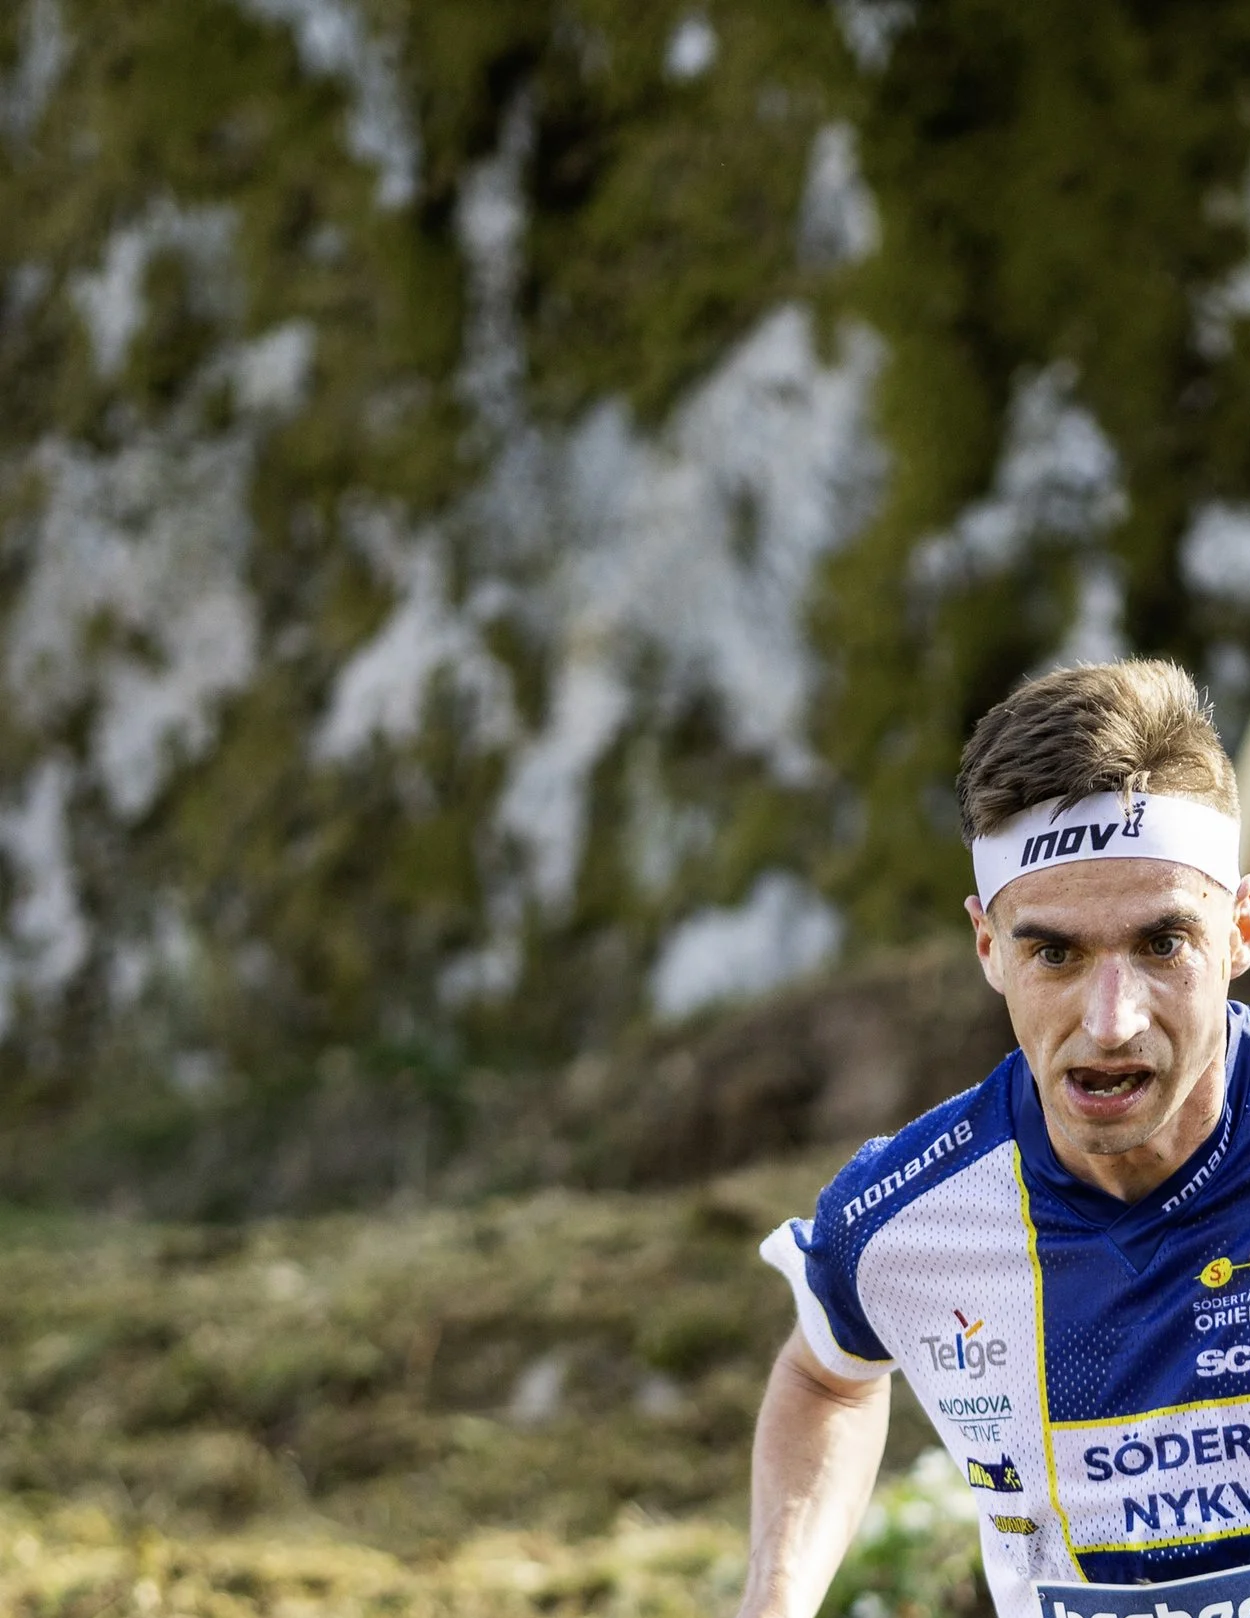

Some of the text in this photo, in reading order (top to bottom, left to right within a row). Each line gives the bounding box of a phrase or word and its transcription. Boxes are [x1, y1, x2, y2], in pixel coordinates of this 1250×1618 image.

[842, 1118, 974, 1228] noname
[920, 1332, 1008, 1380] Telge
[939, 1394, 1012, 1417] AVONOVA
